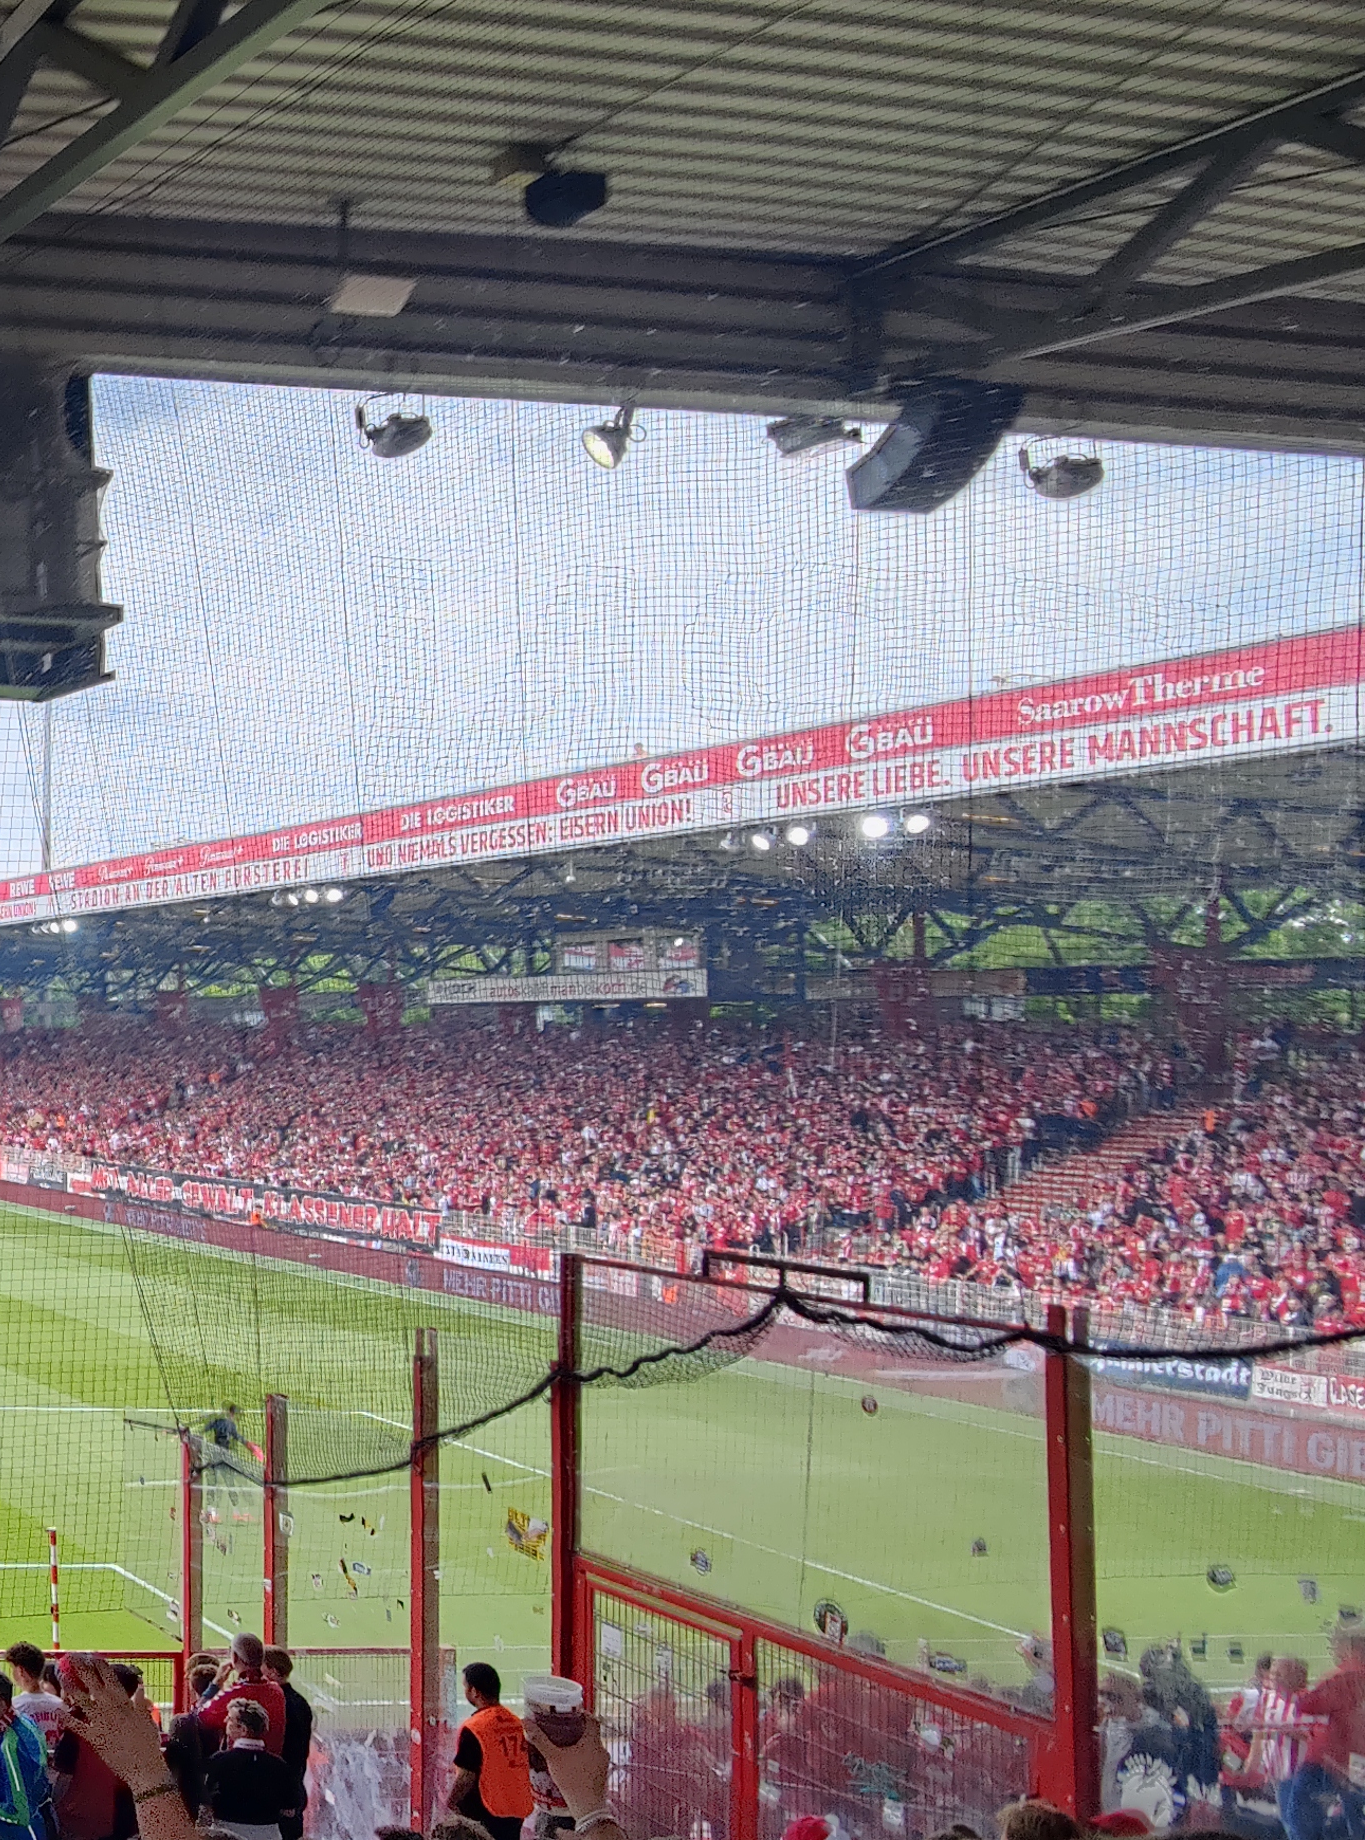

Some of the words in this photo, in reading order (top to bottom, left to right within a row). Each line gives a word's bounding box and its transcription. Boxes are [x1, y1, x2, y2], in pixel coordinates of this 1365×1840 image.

[1017, 665, 1266, 726] SaarowTherme
[776, 770, 866, 809] UNSERE
[873, 758, 951, 797] LIEBE.
[962, 736, 1075, 784] UNSERE
[1087, 697, 1334, 766] MANNSCHAFT.
[367, 848, 394, 869] UND
[461, 821, 555, 856] VERGESSEN:
[559, 809, 619, 842] EISERN
[625, 798, 694, 832] UNION!
[427, 795, 515, 827] LOGISTIKER
[272, 836, 290, 852] DIE
[294, 821, 362, 850] LOGISTIKER
[10, 878, 35, 898] REWE
[70, 887, 119, 910] STADION
[124, 884, 139, 902] AN
[146, 880, 169, 899] DER
[175, 872, 217, 896] ALTEN
[1094, 1393, 1185, 1442] MEHR
[1197, 1409, 1296, 1465] PITTI
